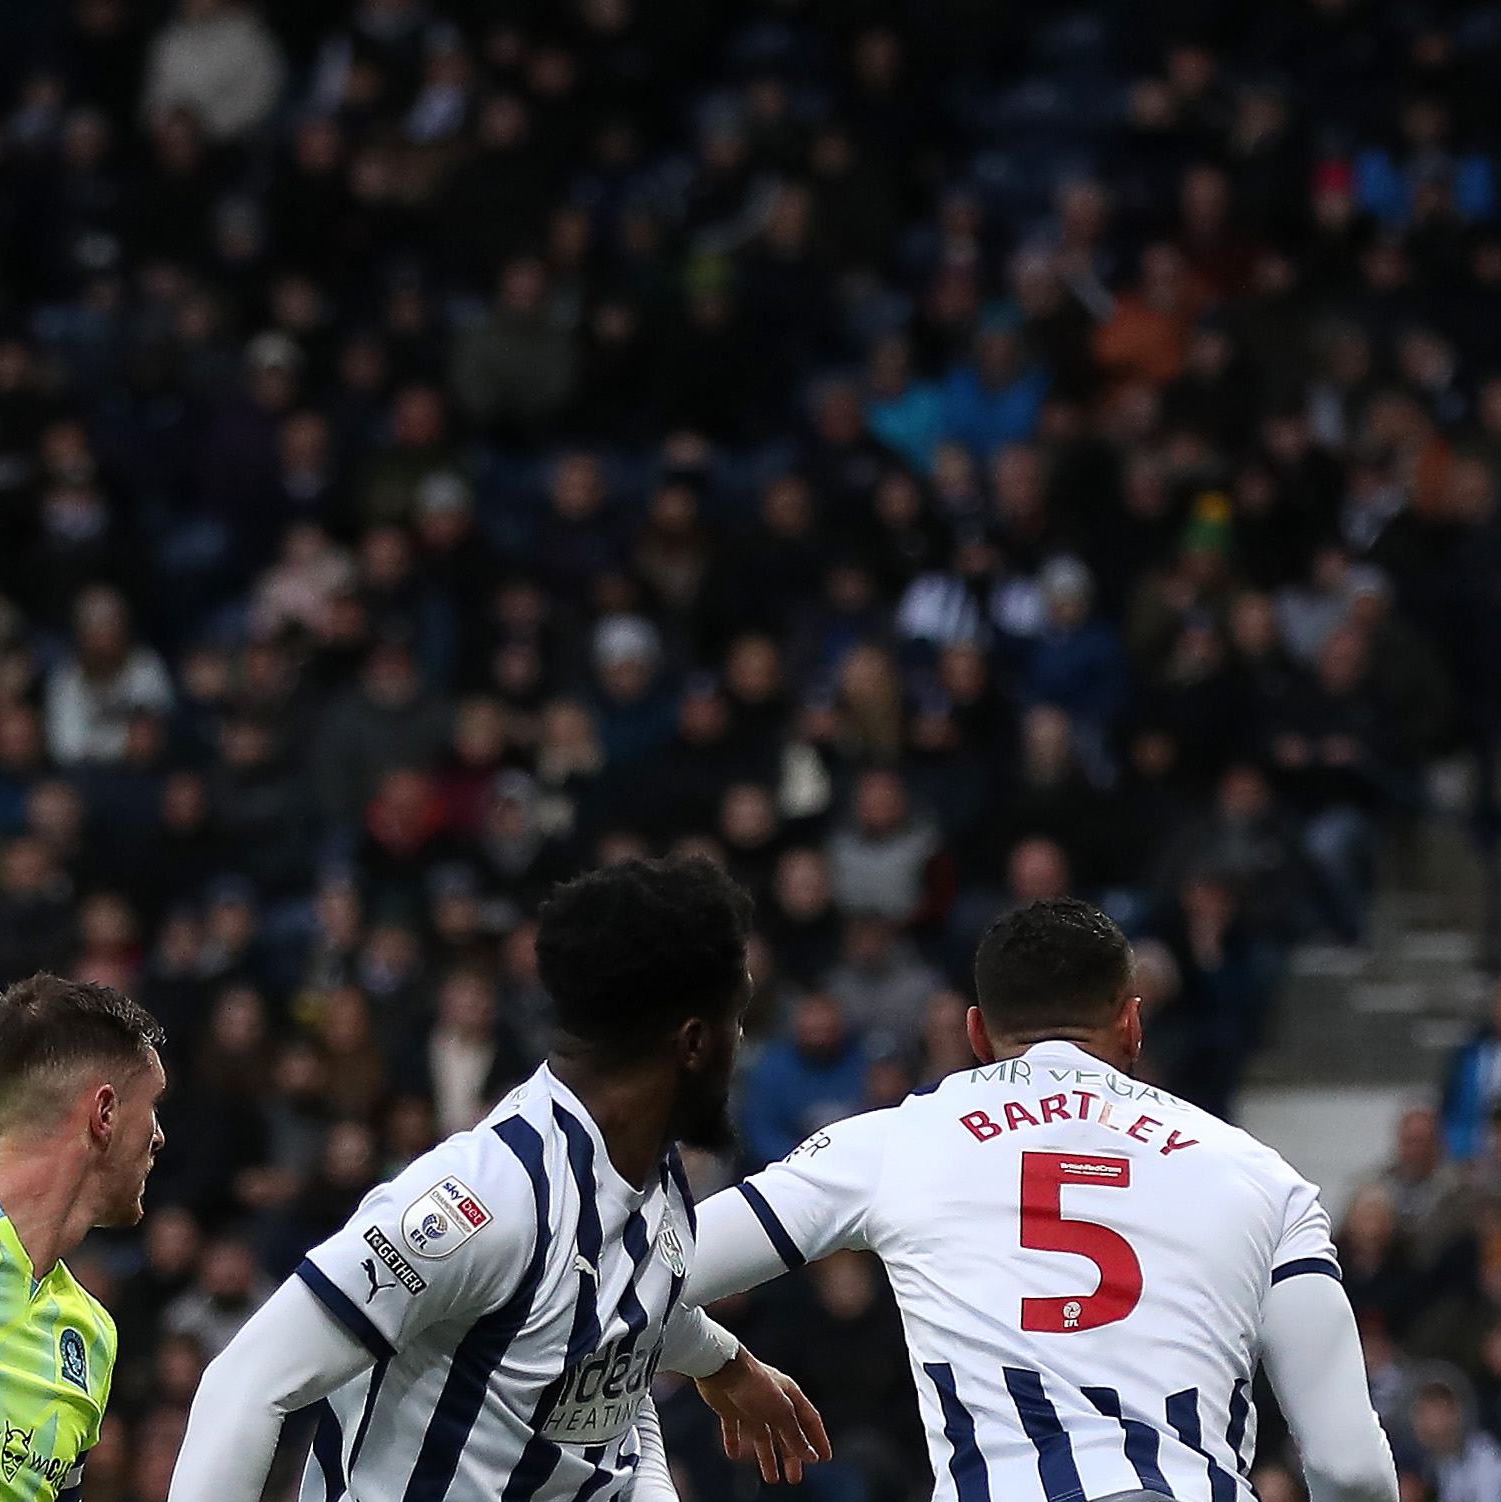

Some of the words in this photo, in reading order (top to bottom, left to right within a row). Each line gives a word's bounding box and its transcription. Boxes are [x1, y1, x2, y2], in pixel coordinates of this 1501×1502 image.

[970, 1060, 1032, 1086] MR
[959, 1090, 1200, 1156] BARTLEY
[442, 1181, 464, 1201] sky
[460, 1199, 484, 1225] bet
[409, 1228, 429, 1250] EFL
[1021, 1151, 1143, 1334] 5
[1063, 1319, 1079, 1328] EFL
